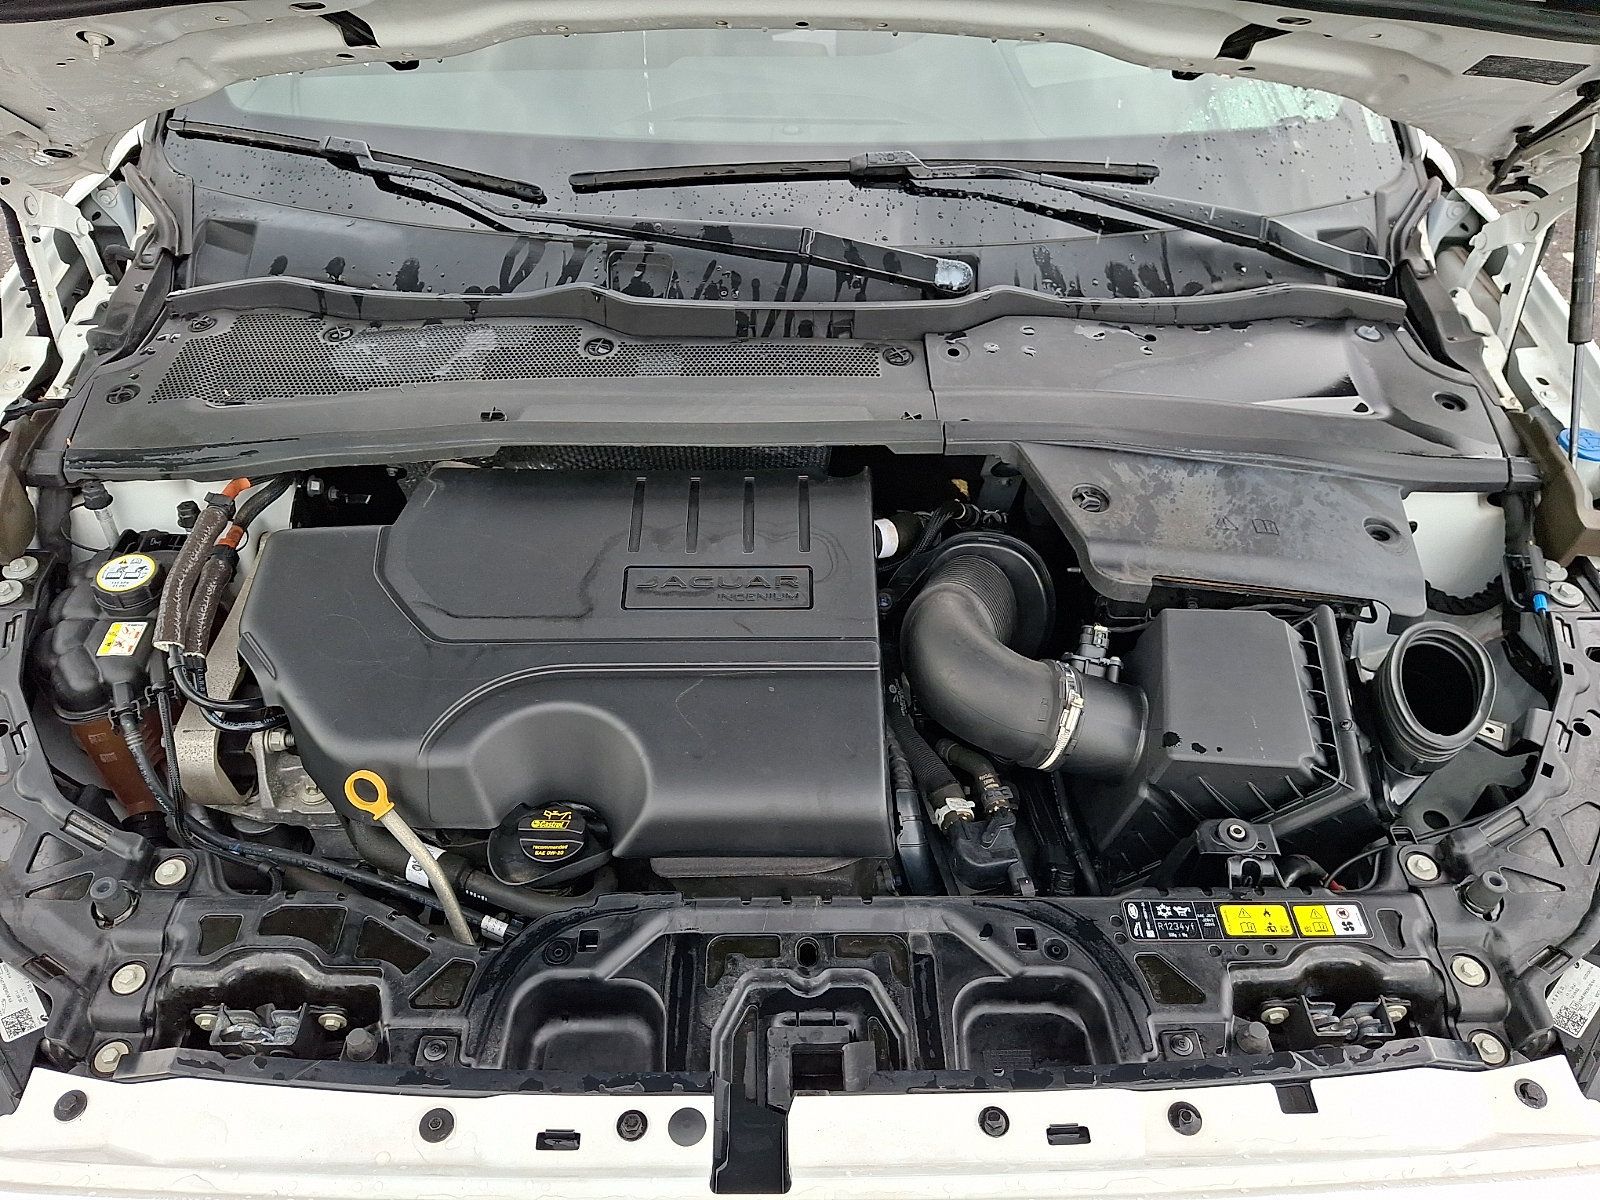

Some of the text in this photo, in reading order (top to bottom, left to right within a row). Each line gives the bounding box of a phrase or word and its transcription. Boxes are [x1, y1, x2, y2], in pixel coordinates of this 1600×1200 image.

[636, 575, 800, 589] JAGUAR
[717, 592, 799, 602] INGENIUM
[1157, 921, 1195, 932] R1234yf
